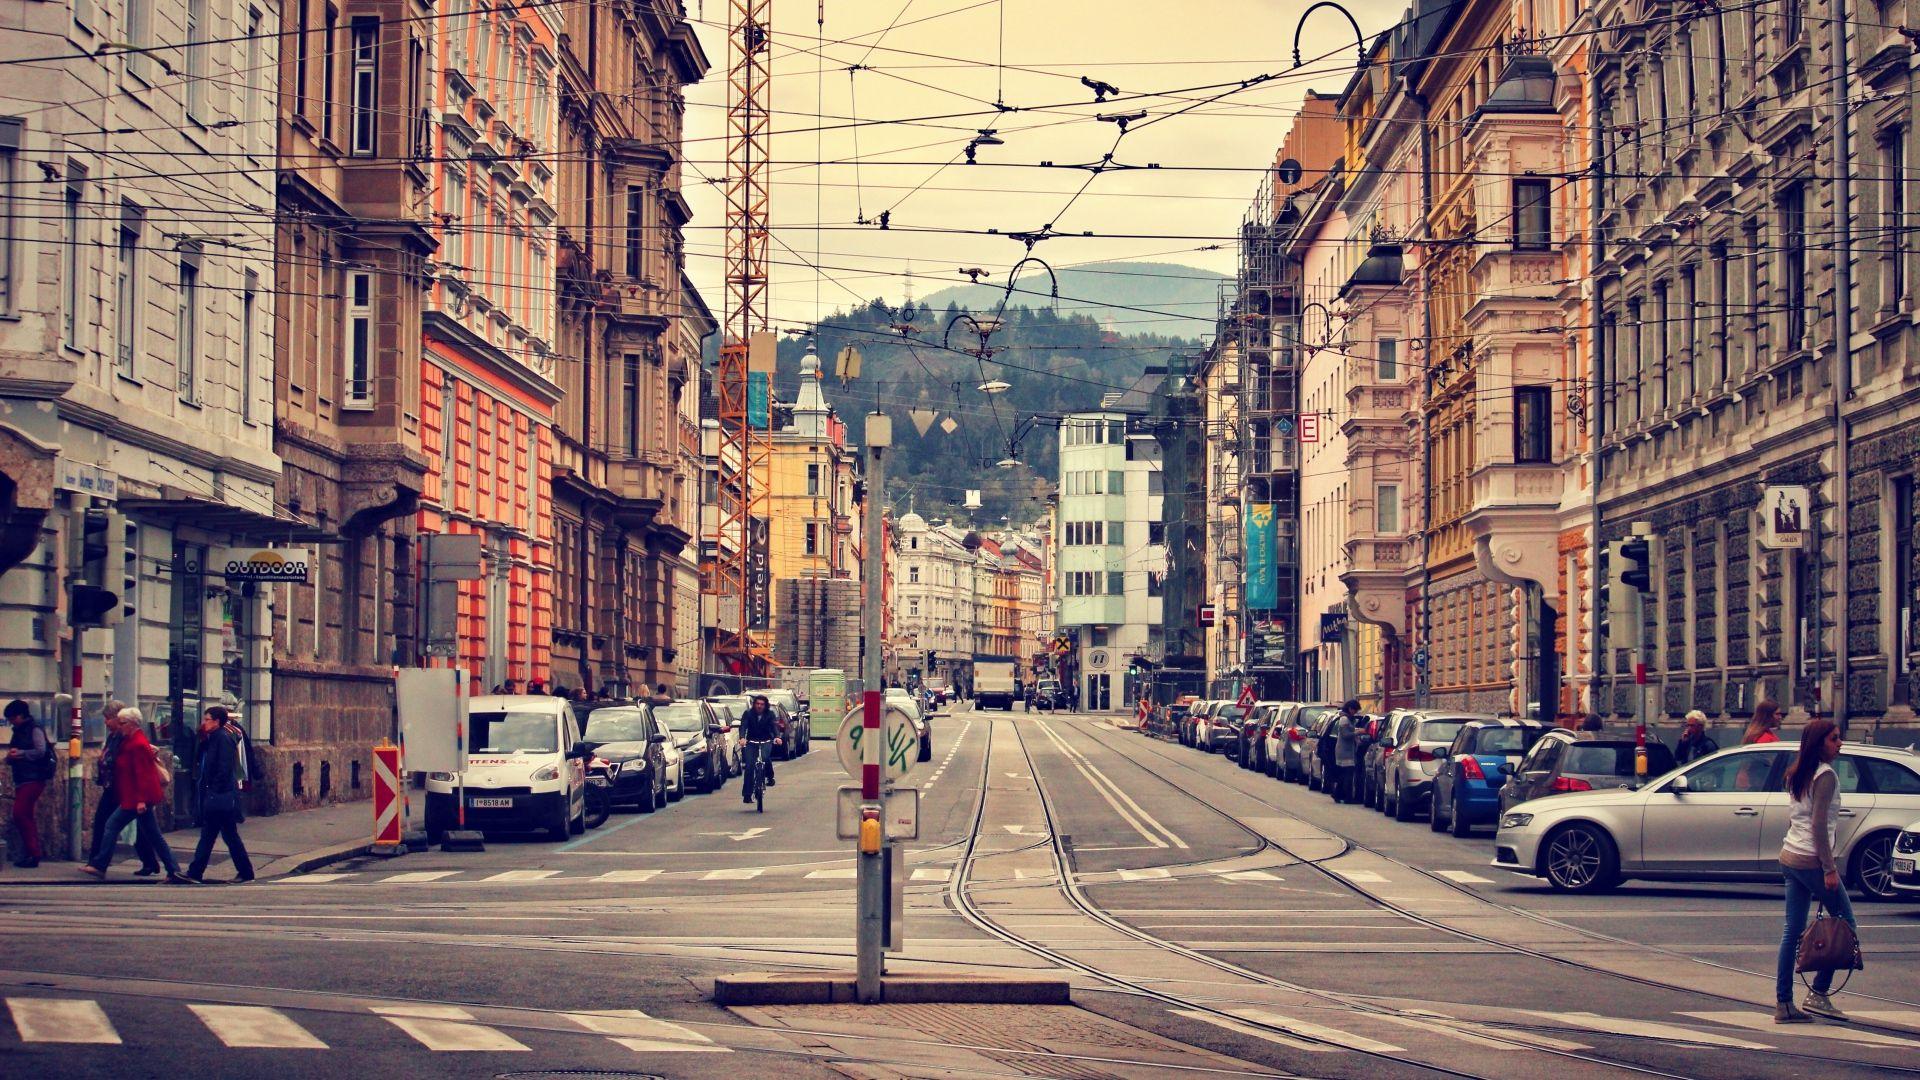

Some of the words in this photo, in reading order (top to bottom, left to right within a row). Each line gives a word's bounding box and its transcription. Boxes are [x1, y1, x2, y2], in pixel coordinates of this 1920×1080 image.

[1303, 418, 1315, 438] E
[227, 560, 306, 574] OUTDOOR
[755, 554, 764, 625] umfeld
